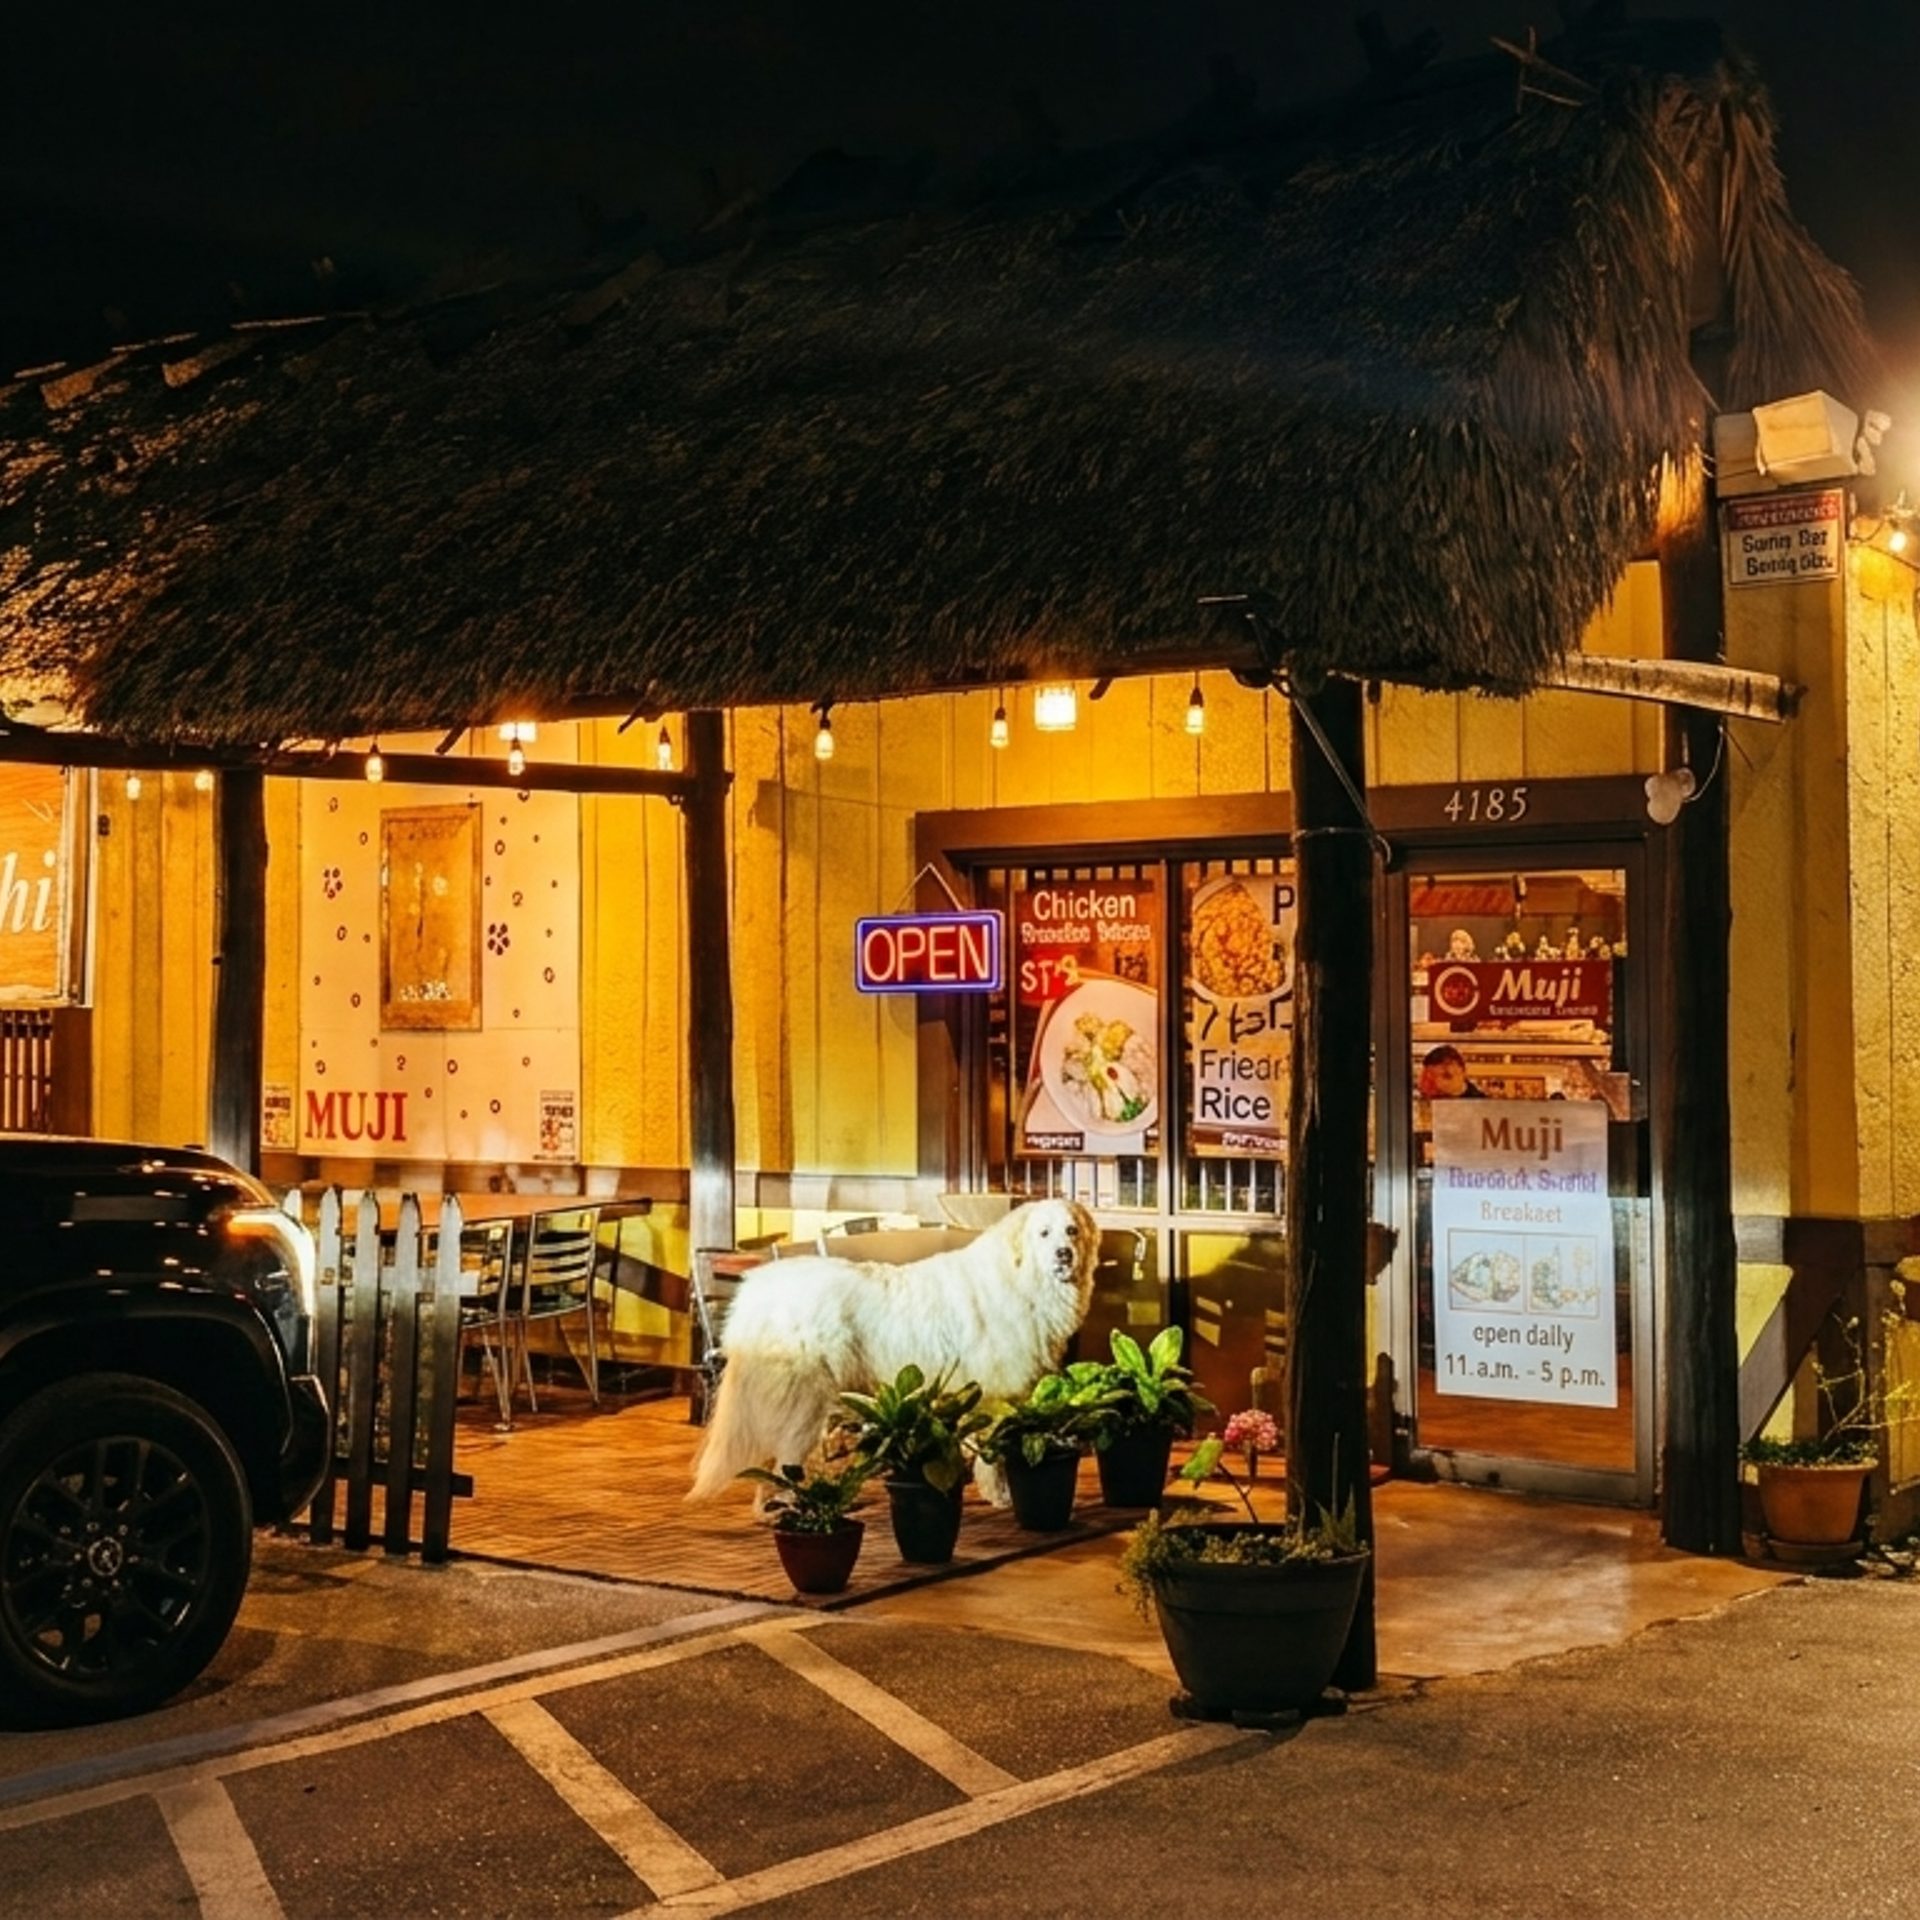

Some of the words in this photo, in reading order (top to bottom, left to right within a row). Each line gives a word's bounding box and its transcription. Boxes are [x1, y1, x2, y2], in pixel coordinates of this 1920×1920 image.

[1444, 787, 1528, 822] 4185
[1032, 890, 1136, 920] Chicken
[864, 926, 989, 983] OPEN
[1492, 967, 1582, 1008] Muji
[304, 1090, 408, 1142] MUJI
[1201, 1086, 1271, 1120] Rice
[1481, 1117, 1563, 1160] Muji
